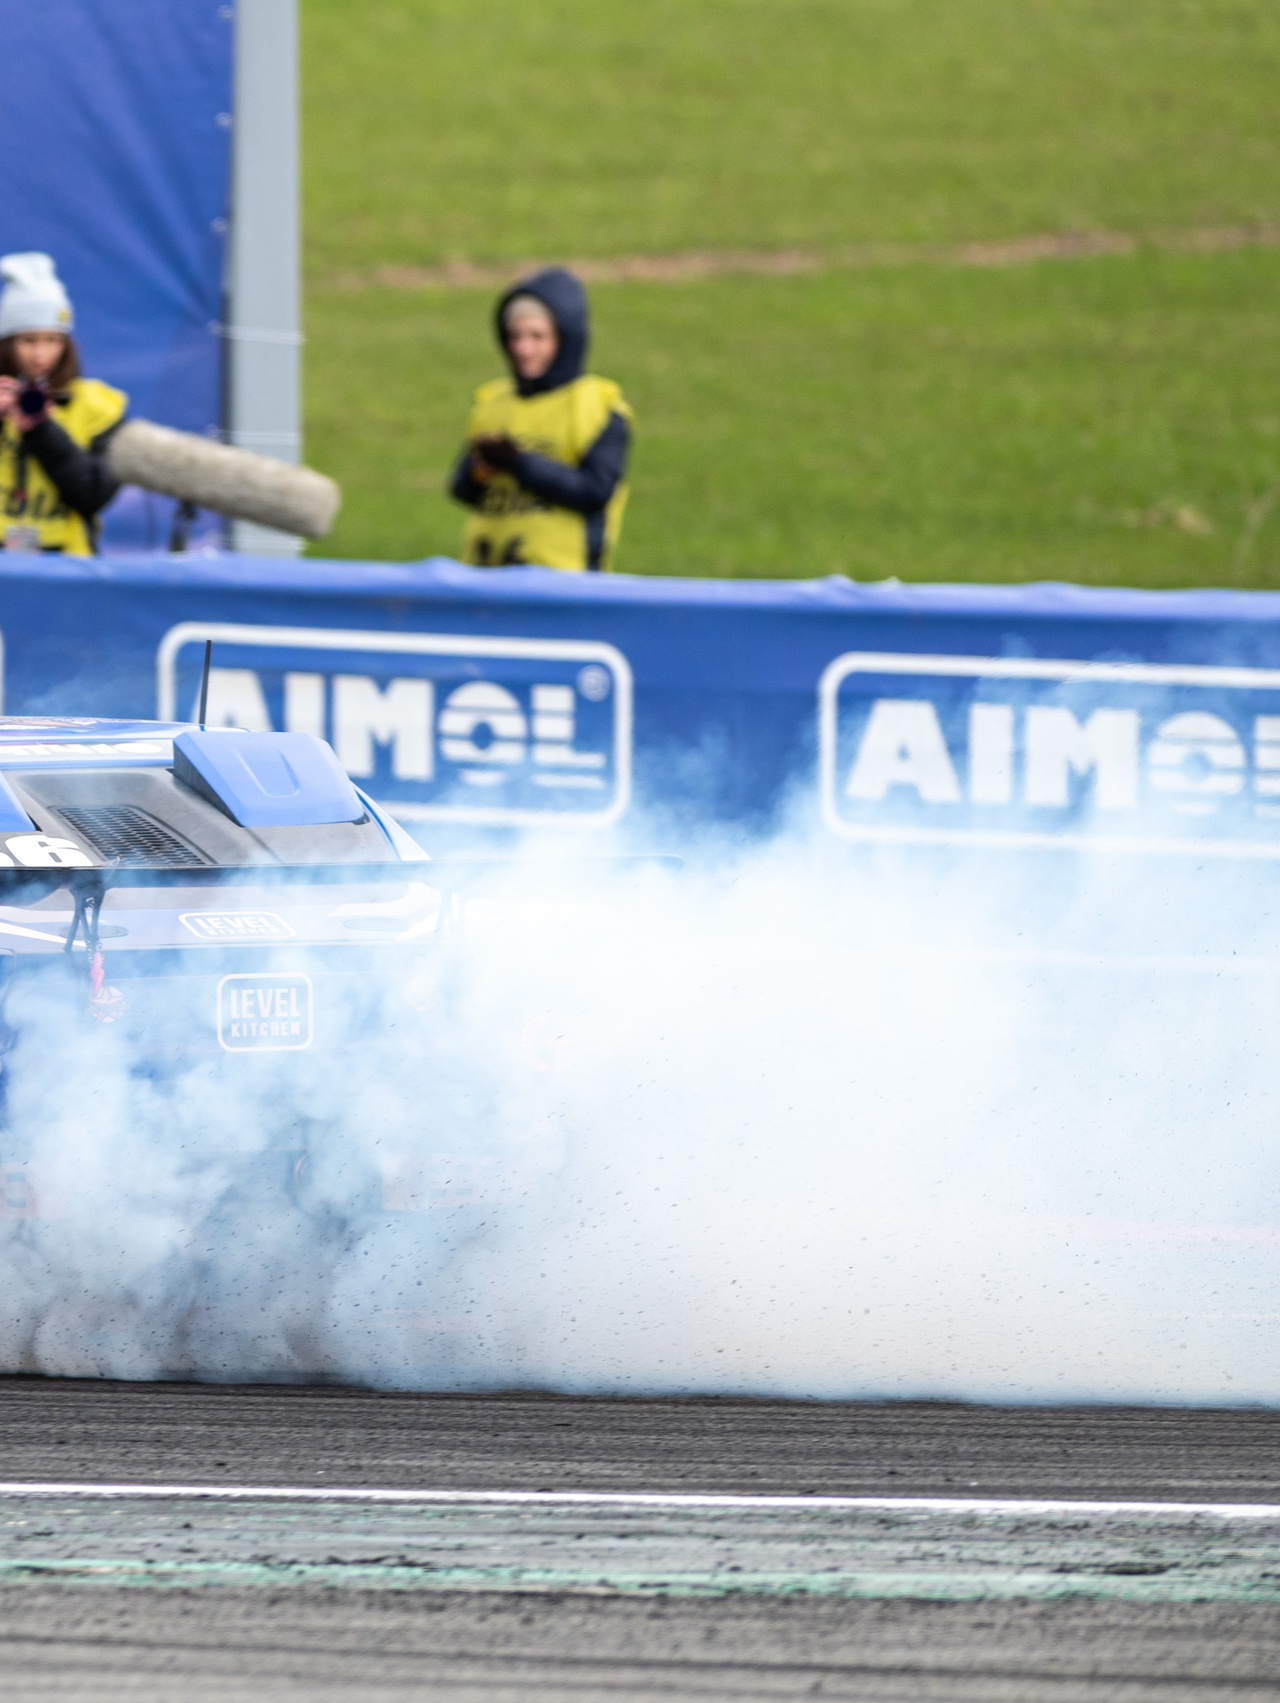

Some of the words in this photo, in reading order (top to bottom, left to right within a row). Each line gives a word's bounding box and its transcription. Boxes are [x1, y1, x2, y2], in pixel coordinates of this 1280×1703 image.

[194, 668, 607, 788] AIMOL
[194, 917, 276, 930] LEVEL
[230, 987, 300, 1019] LEVEL
[230, 1021, 300, 1038] KITCHEN
